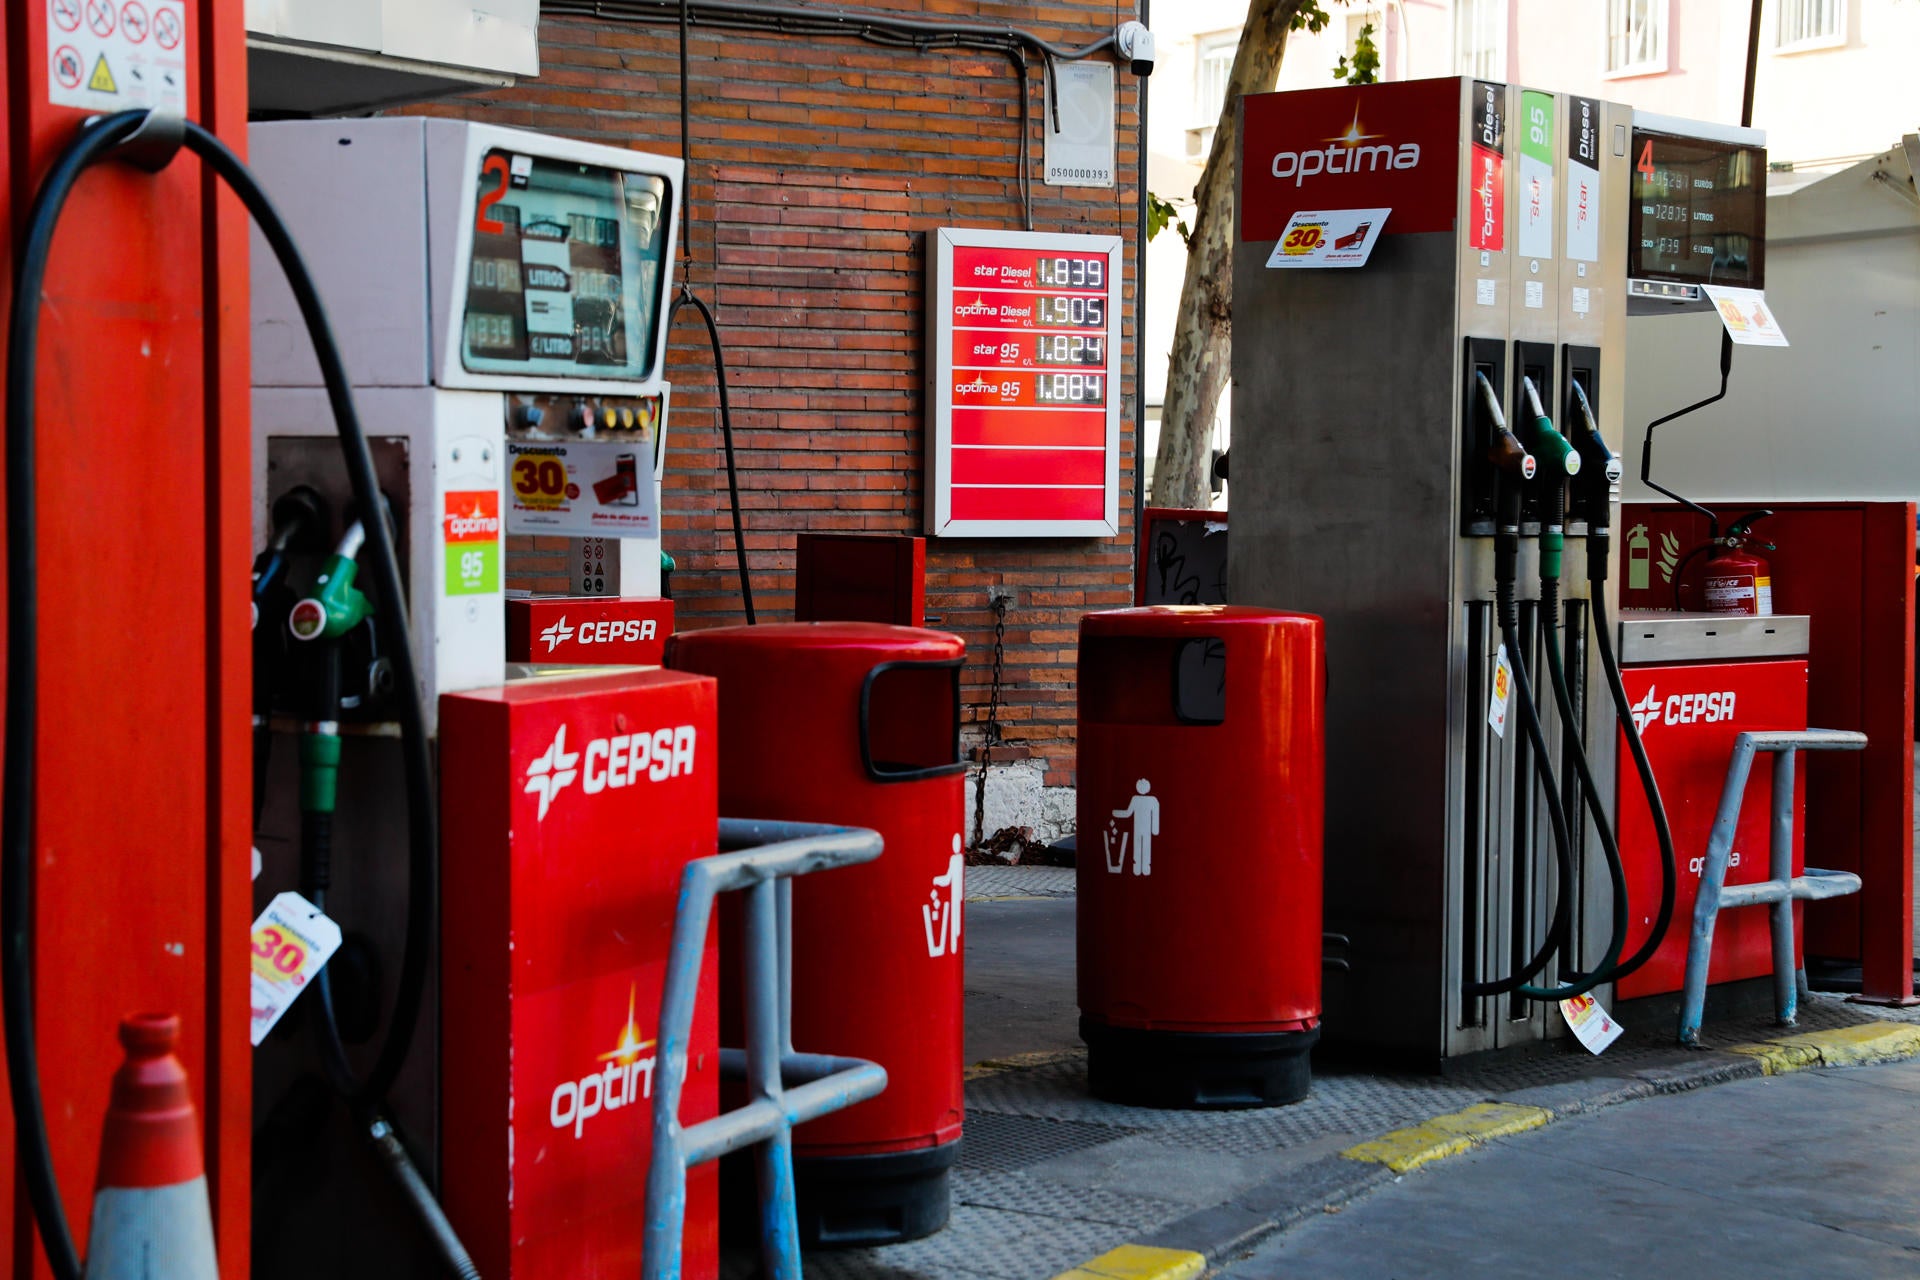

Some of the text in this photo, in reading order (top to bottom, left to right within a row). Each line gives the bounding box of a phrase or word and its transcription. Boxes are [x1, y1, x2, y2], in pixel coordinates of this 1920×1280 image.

[1483, 85, 1495, 145] Diesel
[1530, 106, 1545, 145] 95
[1579, 100, 1590, 159] Diesel
[1051, 168, 1109, 179] 0500000393
[1272, 143, 1421, 187] optima
[1637, 139, 1655, 184] 4
[476, 154, 510, 235] 2
[1483, 157, 1495, 236] optima
[1532, 178, 1540, 217] star
[1694, 179, 1713, 189] EUROS
[1579, 184, 1588, 222] star
[1693, 212, 1714, 222] LITROS
[1285, 229, 1321, 247] 30
[528, 269, 566, 287] LITROS
[974, 258, 1101, 286] star Diesel 1.839
[955, 297, 1101, 324] optima Diesel 1.905
[973, 335, 1100, 362] star 95 1.824
[955, 374, 1099, 400] optima 95 1.884
[509, 445, 567, 456] Descuento
[515, 460, 564, 495] 30
[451, 516, 498, 538] optima
[461, 551, 483, 579] 95
[578, 619, 656, 644] CEPSA
[1664, 691, 1736, 725] CEPSA
[583, 725, 696, 795] CEPSA
[252, 928, 304, 974] 30
[551, 1055, 686, 1139] optim
